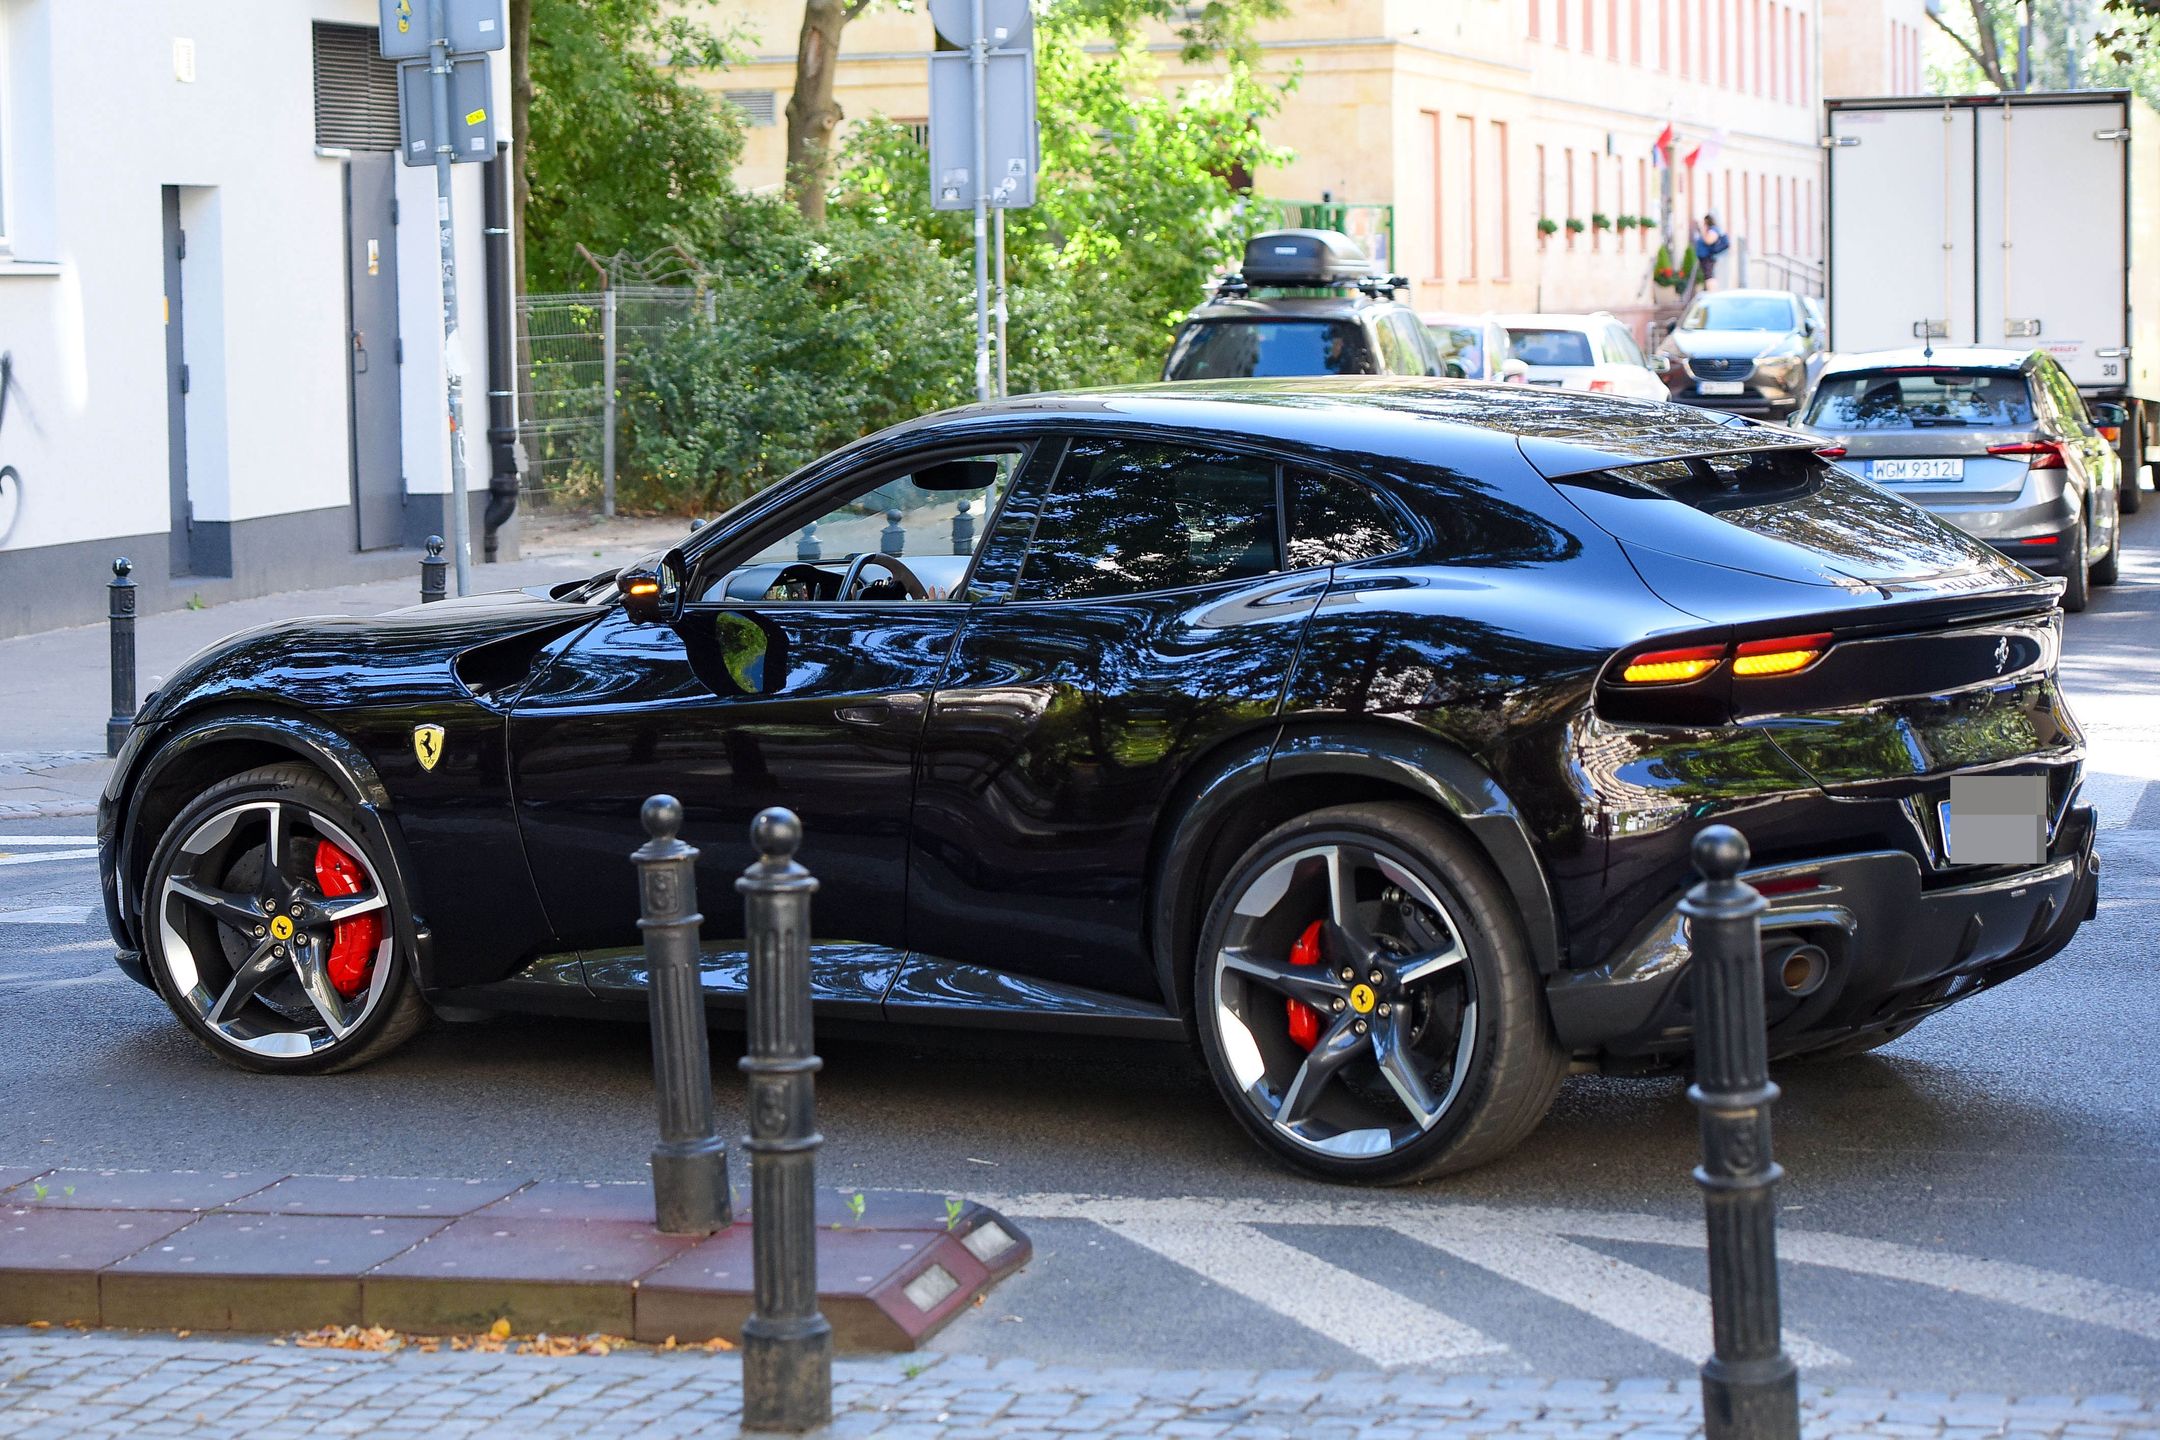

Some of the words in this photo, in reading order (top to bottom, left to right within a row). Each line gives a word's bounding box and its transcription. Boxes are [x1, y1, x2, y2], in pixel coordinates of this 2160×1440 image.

[2103, 364, 2117, 376] 30
[1876, 462, 1906, 478] WGM
[1912, 461, 1960, 477] 9312L
